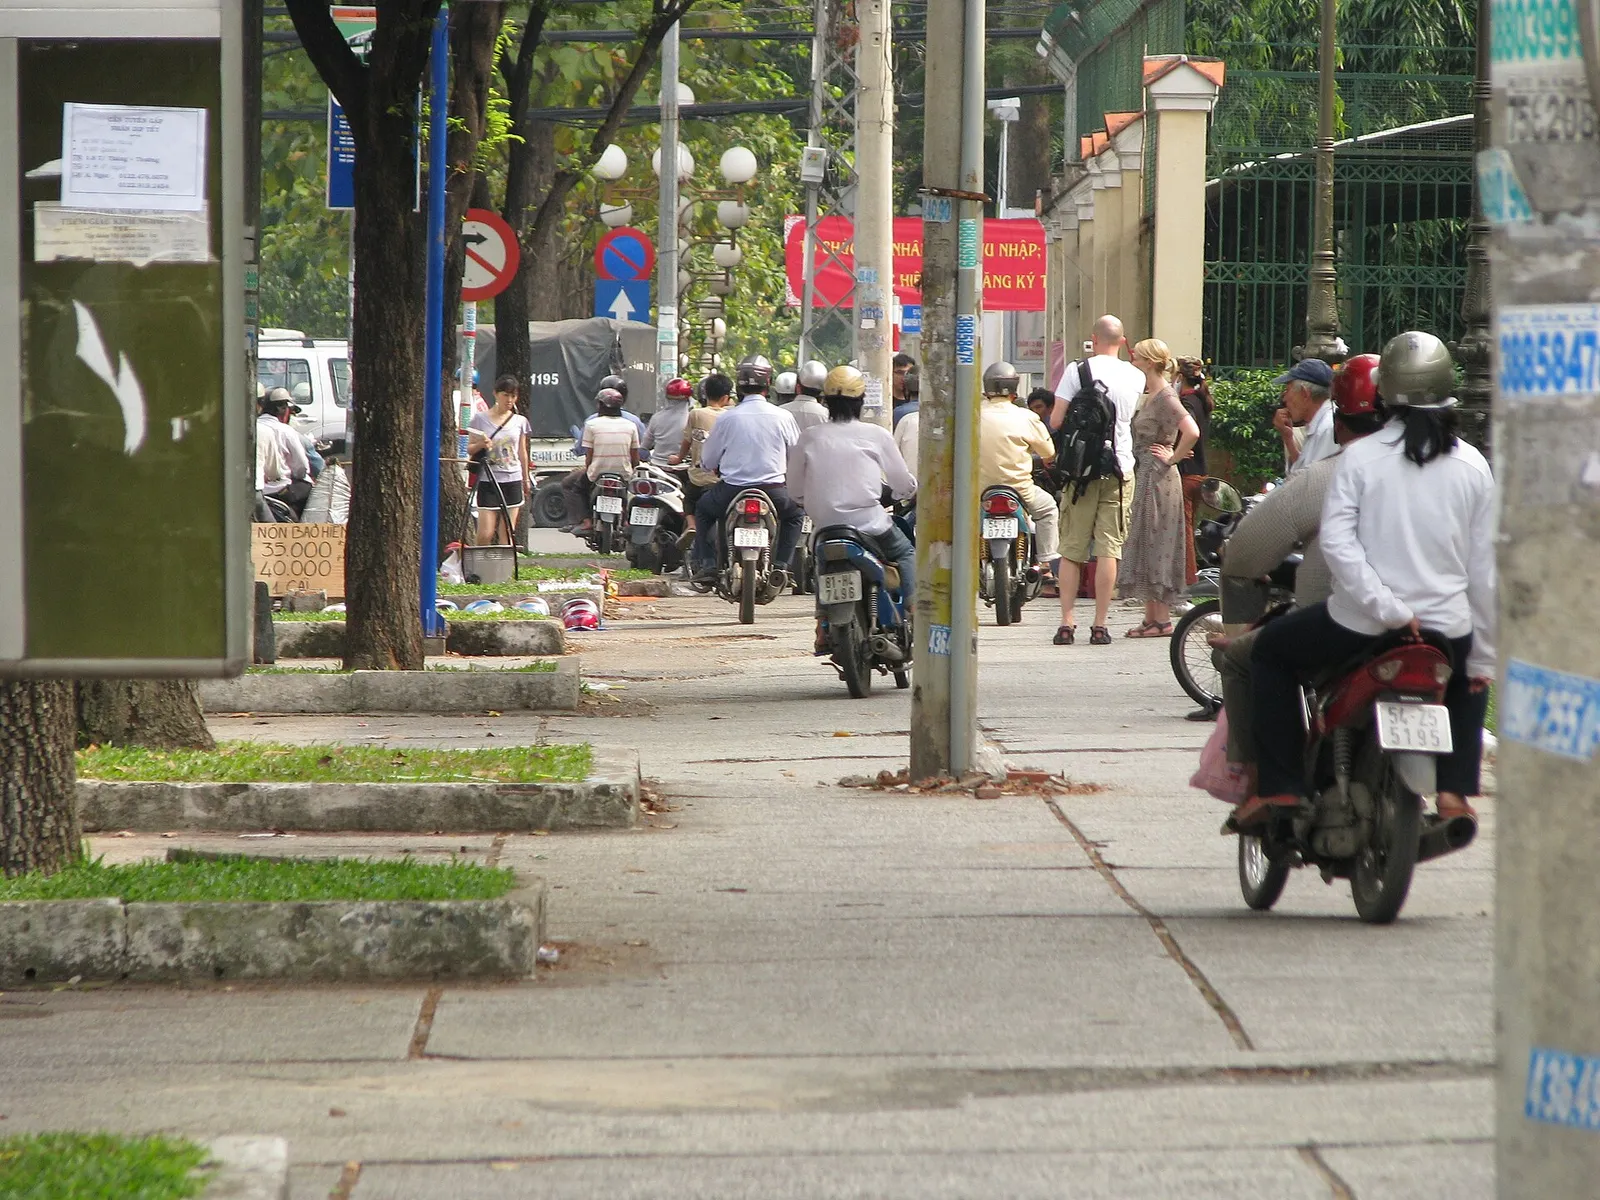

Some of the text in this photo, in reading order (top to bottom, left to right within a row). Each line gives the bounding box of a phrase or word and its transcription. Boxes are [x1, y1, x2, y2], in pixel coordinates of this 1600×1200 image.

[999, 240, 1042, 260] NHẬP;
[1016, 271, 1036, 289] KÝ
[261, 541, 332, 558] 35.000
[260, 560, 332, 578] 40.000
[1389, 726, 1440, 747] 5195
